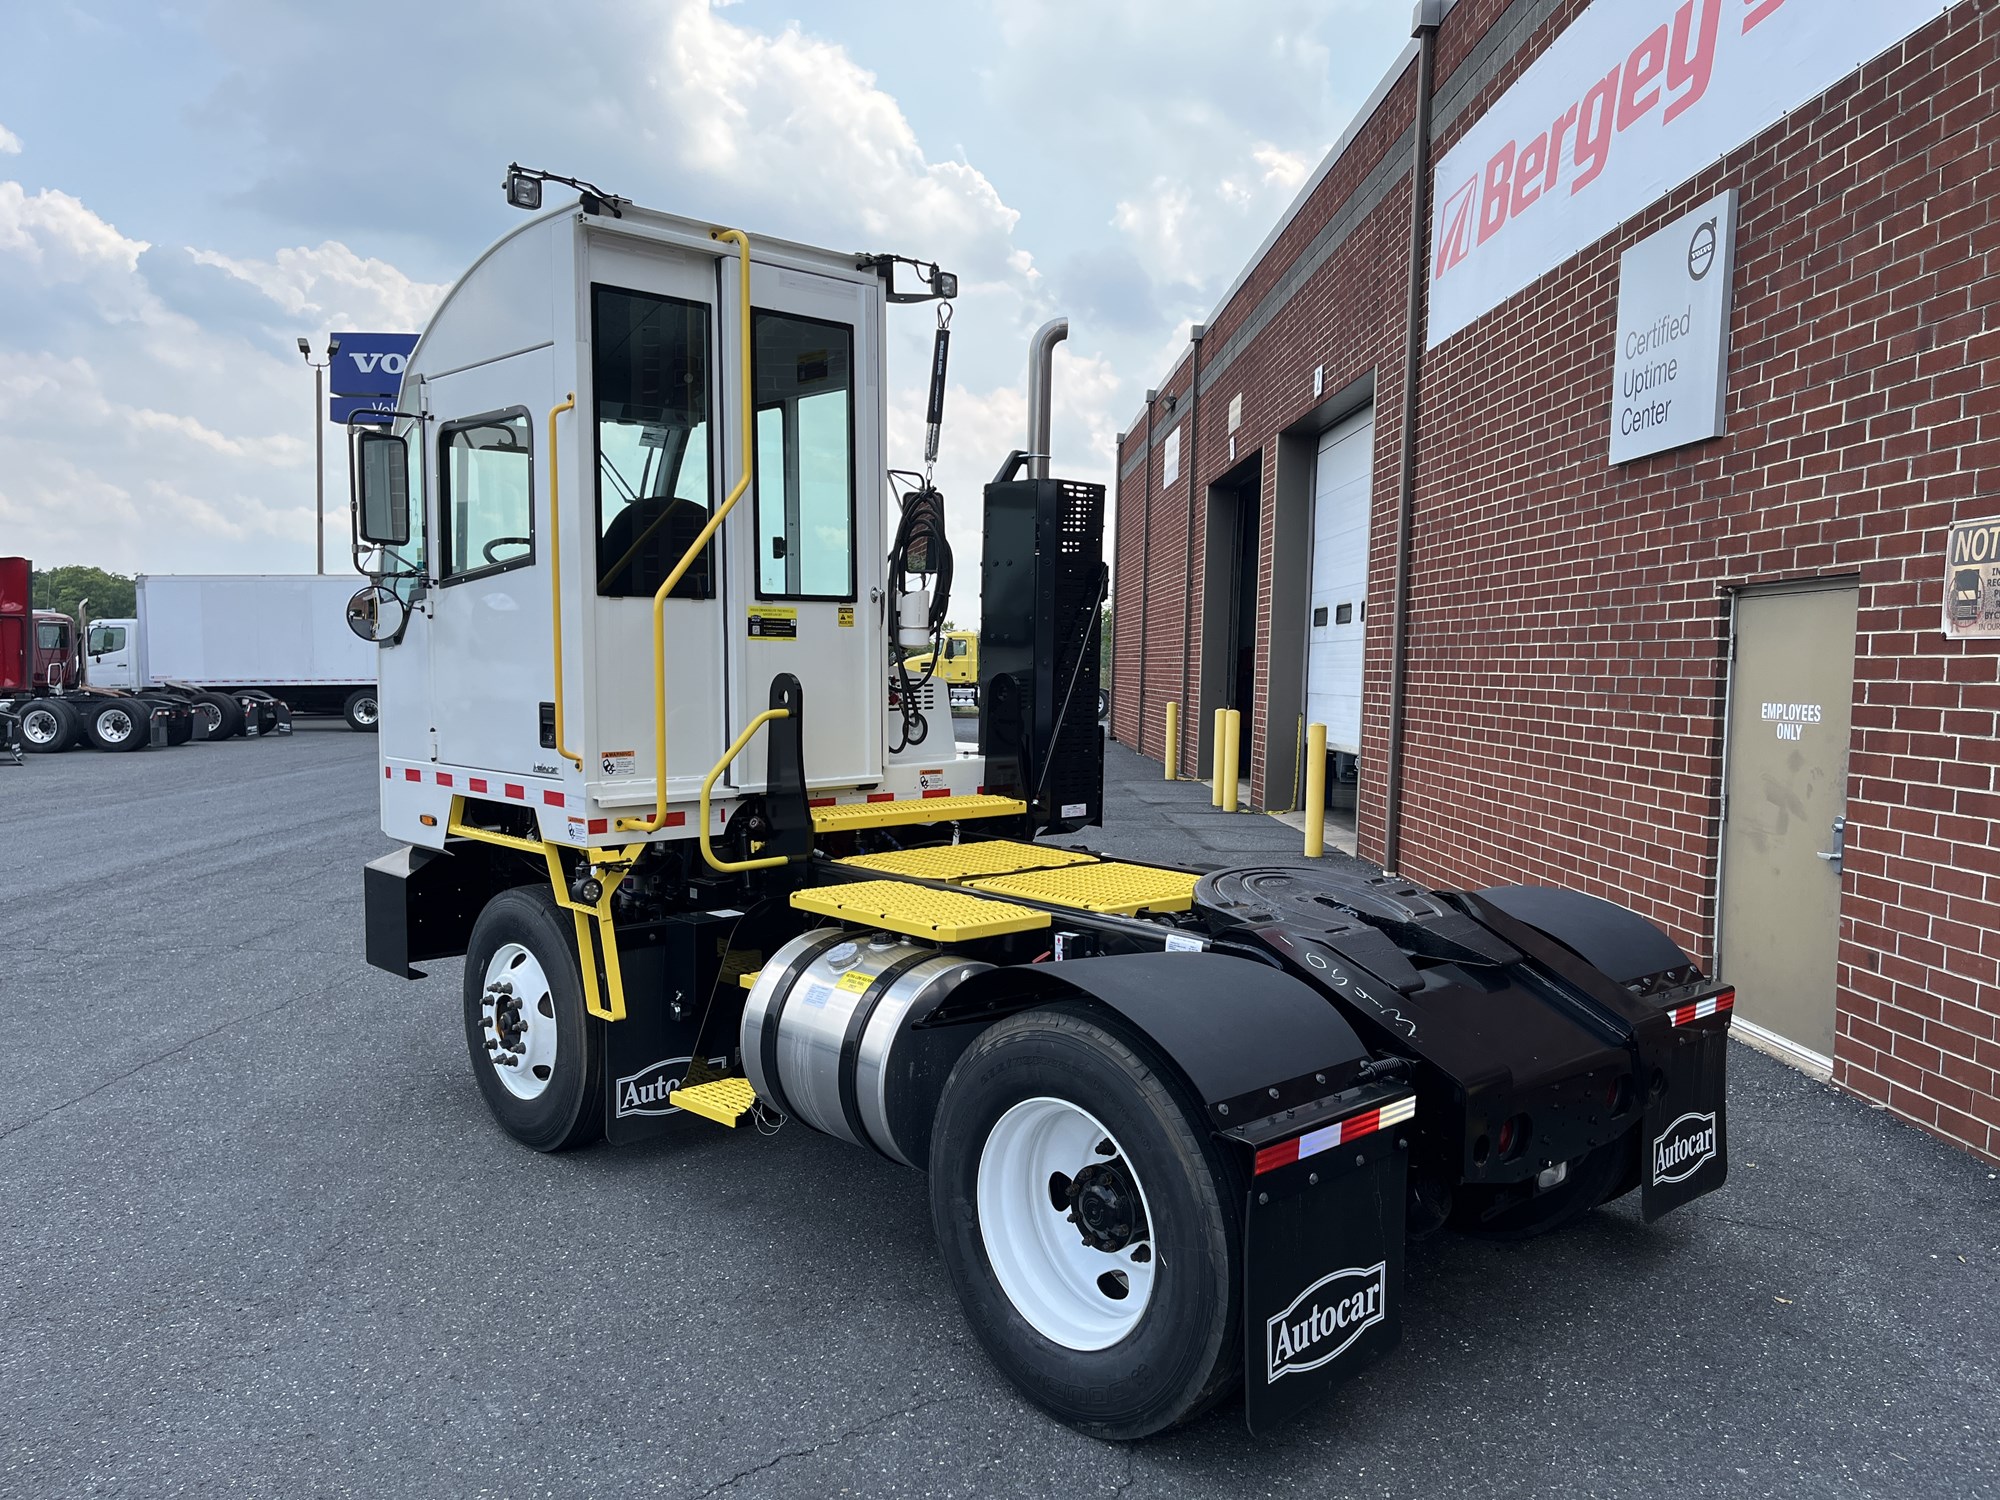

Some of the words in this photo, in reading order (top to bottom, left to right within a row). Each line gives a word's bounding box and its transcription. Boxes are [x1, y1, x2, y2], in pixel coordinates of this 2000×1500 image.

[1691, 244, 1713, 260] VOLVO
[1625, 304, 1691, 360] Certified
[348, 352, 411, 375] VO
[1623, 358, 1677, 401] Uptime
[372, 401, 398, 418] Vol
[1621, 399, 1672, 436] Center
[1761, 702, 1821, 723] EMPLOYEES
[1776, 722, 1803, 741] ONLY
[620, 1075, 687, 1109] Auto
[1655, 1127, 1712, 1175] Autocar
[1272, 1282, 1380, 1368] Autocar
